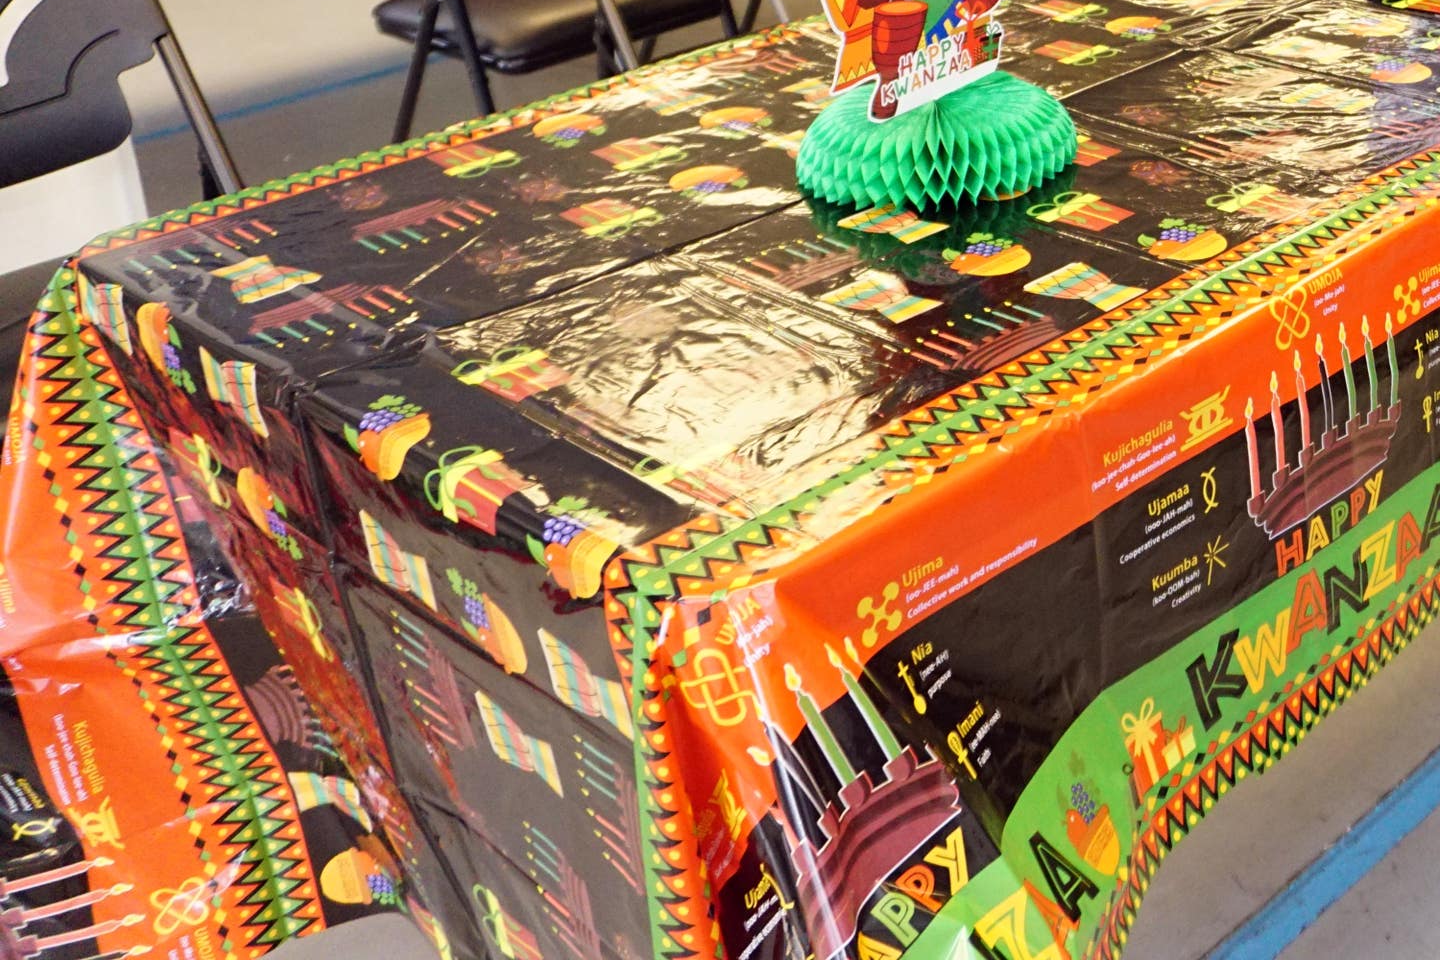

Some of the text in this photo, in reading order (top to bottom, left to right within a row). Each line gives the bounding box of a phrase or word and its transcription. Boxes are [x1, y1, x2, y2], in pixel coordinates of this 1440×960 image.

[900, 33, 964, 76] HAPPY
[881, 50, 972, 104] KWANZAA
[1308, 267, 1343, 295] UMOJA
[1425, 328, 1439, 344] Nia
[1103, 420, 1174, 467] Kujichagulia
[1147, 482, 1190, 517] Ujamaa
[1119, 514, 1195, 565] Cooperative economics
[1275, 469, 1384, 578] HAPPY
[902, 556, 944, 588] Ujima
[907, 537, 1038, 619] Collective work and responsibility
[1151, 555, 1199, 591] Kuumba
[1171, 584, 1201, 609] Creativity
[911, 641, 934, 665] Nia
[956, 700, 984, 739] Imani
[72, 720, 105, 795] Kujichagulia
